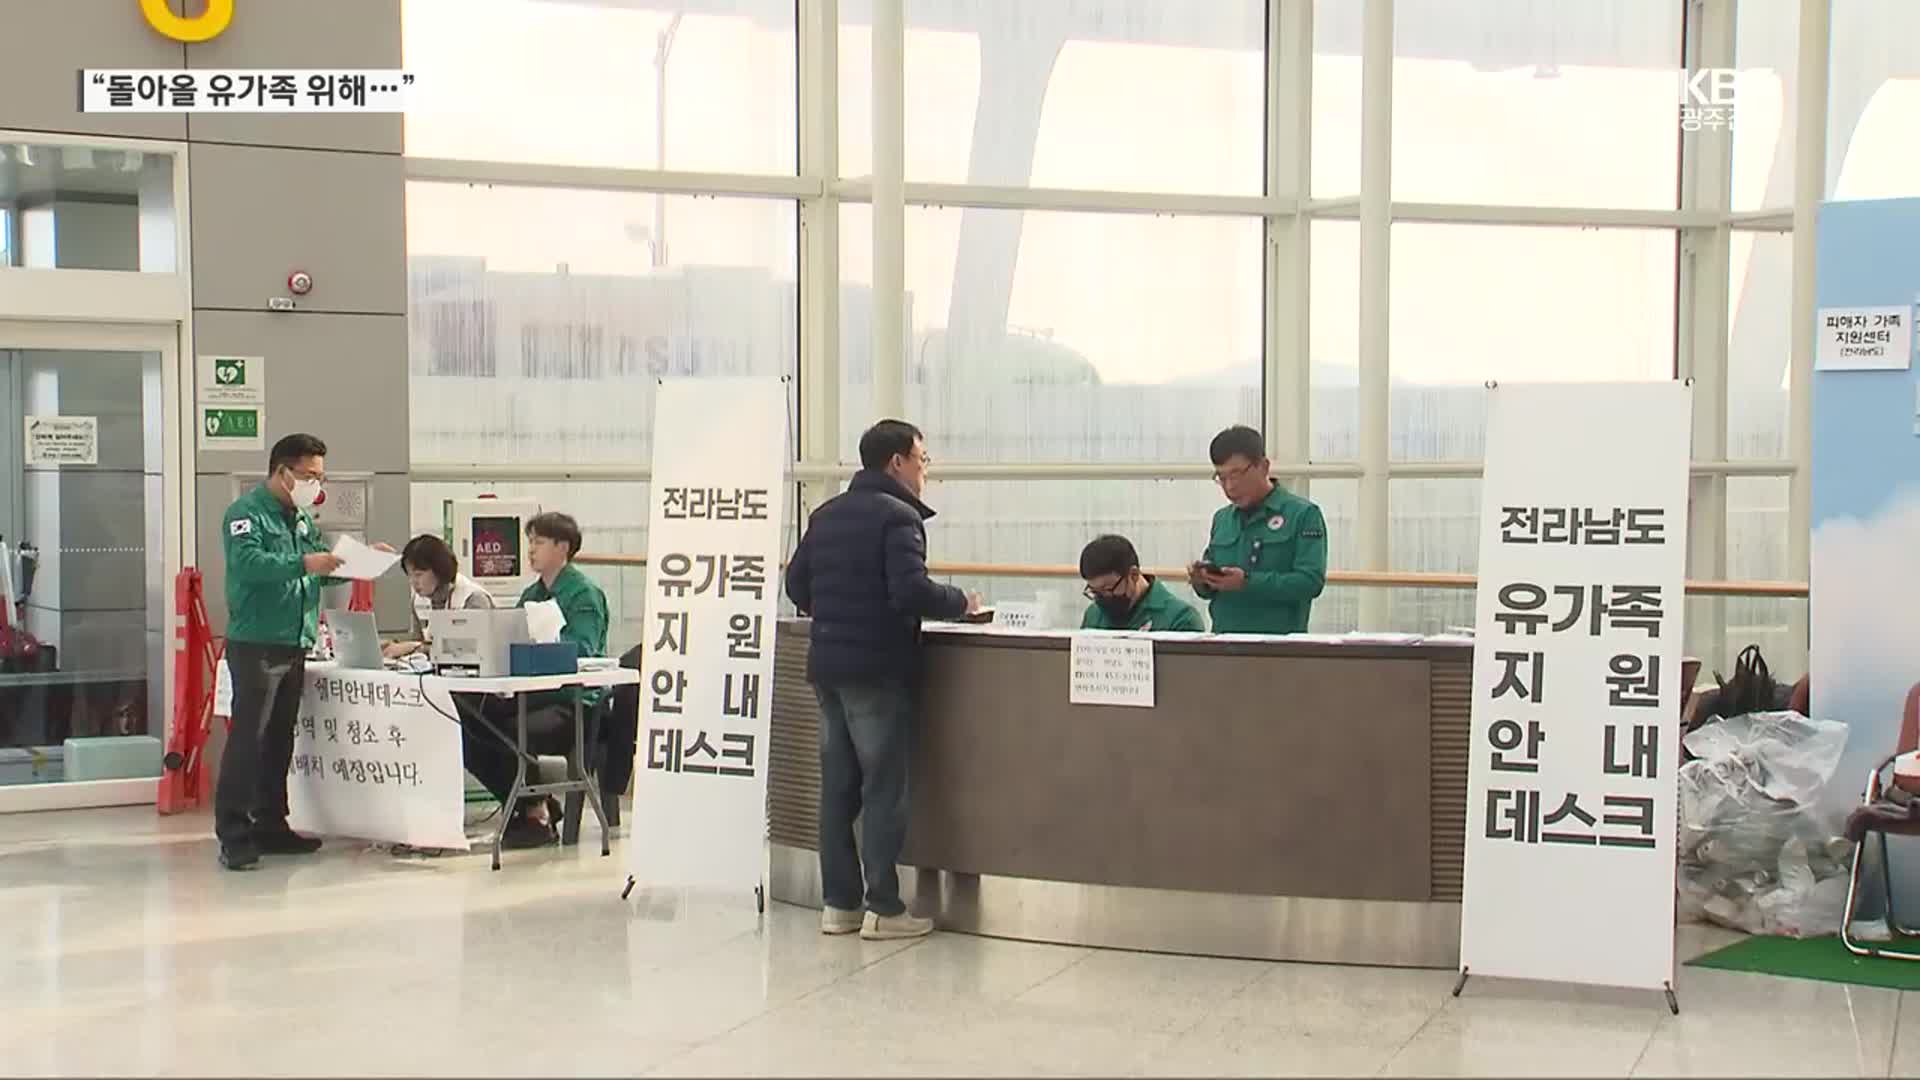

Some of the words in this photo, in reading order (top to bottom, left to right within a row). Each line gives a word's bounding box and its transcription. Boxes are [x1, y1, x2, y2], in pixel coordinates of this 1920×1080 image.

[1826, 316, 1868, 328] 피해자
[1873, 314, 1901, 328] 가족
[1835, 330, 1890, 344] 지원센터
[663, 487, 768, 520] 전라남도
[1500, 506, 1666, 545] 전라남도
[476, 542, 501, 553] AED
[658, 553, 766, 600] 유가족
[1495, 582, 1664, 638] 유가족
[294, 716, 316, 739] 역
[324, 717, 338, 743] 및
[347, 720, 380, 745] 청소
[388, 725, 407, 747] 후
[647, 728, 755, 777] 데스크
[291, 753, 325, 779] 배치
[332, 757, 424, 787] 예정입니다.
[1485, 788, 1656, 849] 데스크
